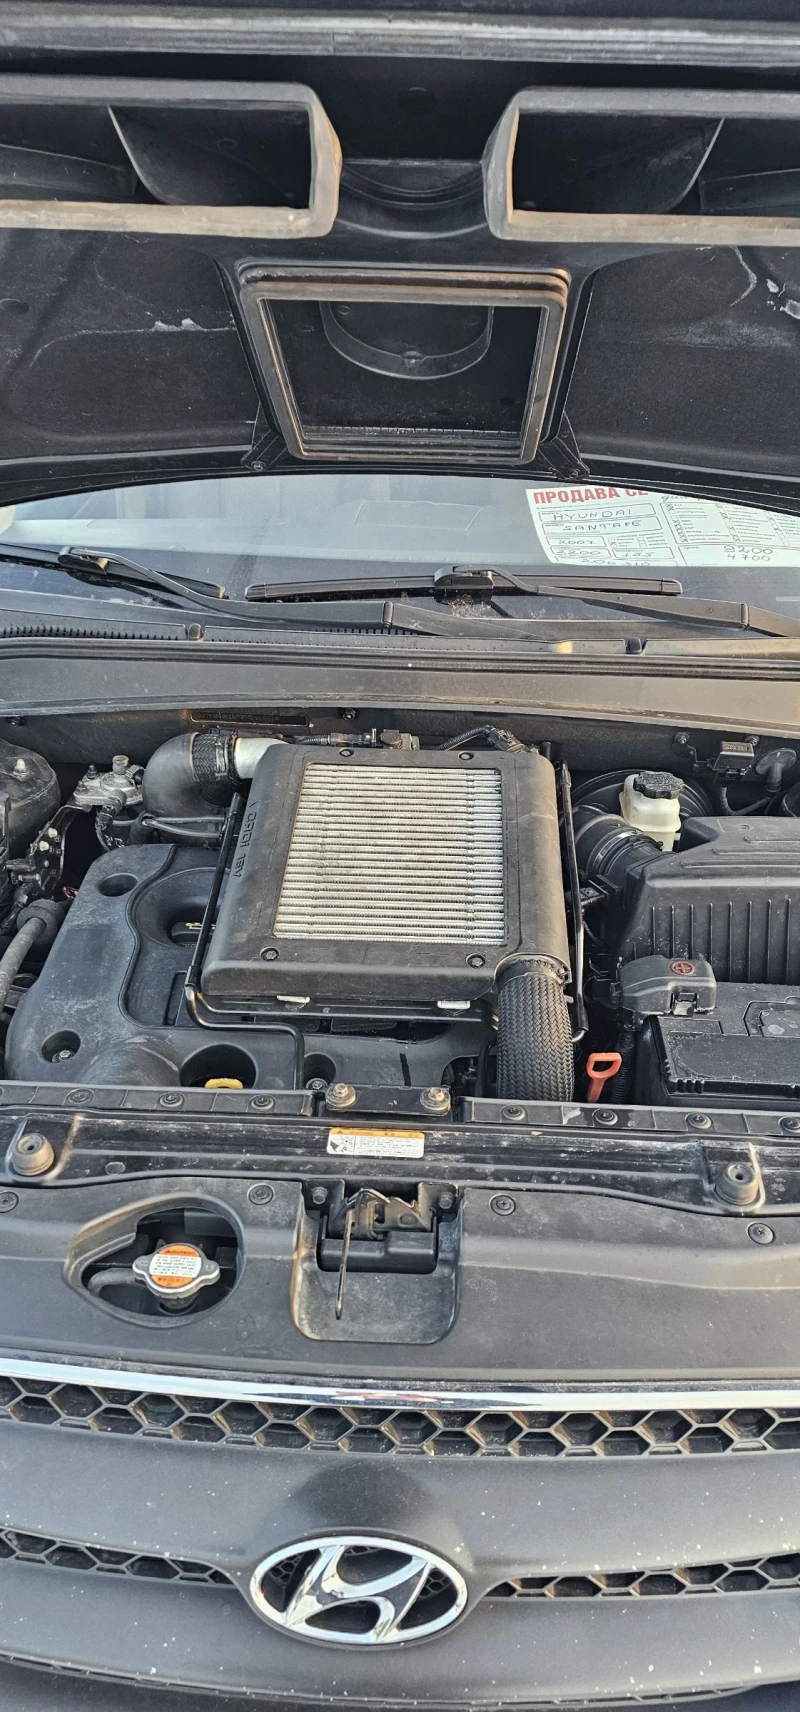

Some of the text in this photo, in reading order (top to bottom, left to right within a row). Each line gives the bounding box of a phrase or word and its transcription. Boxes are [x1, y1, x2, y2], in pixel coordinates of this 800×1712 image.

[533, 487, 621, 504] ПРОДАВА
[553, 508, 632, 521] HYUNDAI
[723, 545, 774, 555] 9200
[726, 553, 772, 562] 4700
